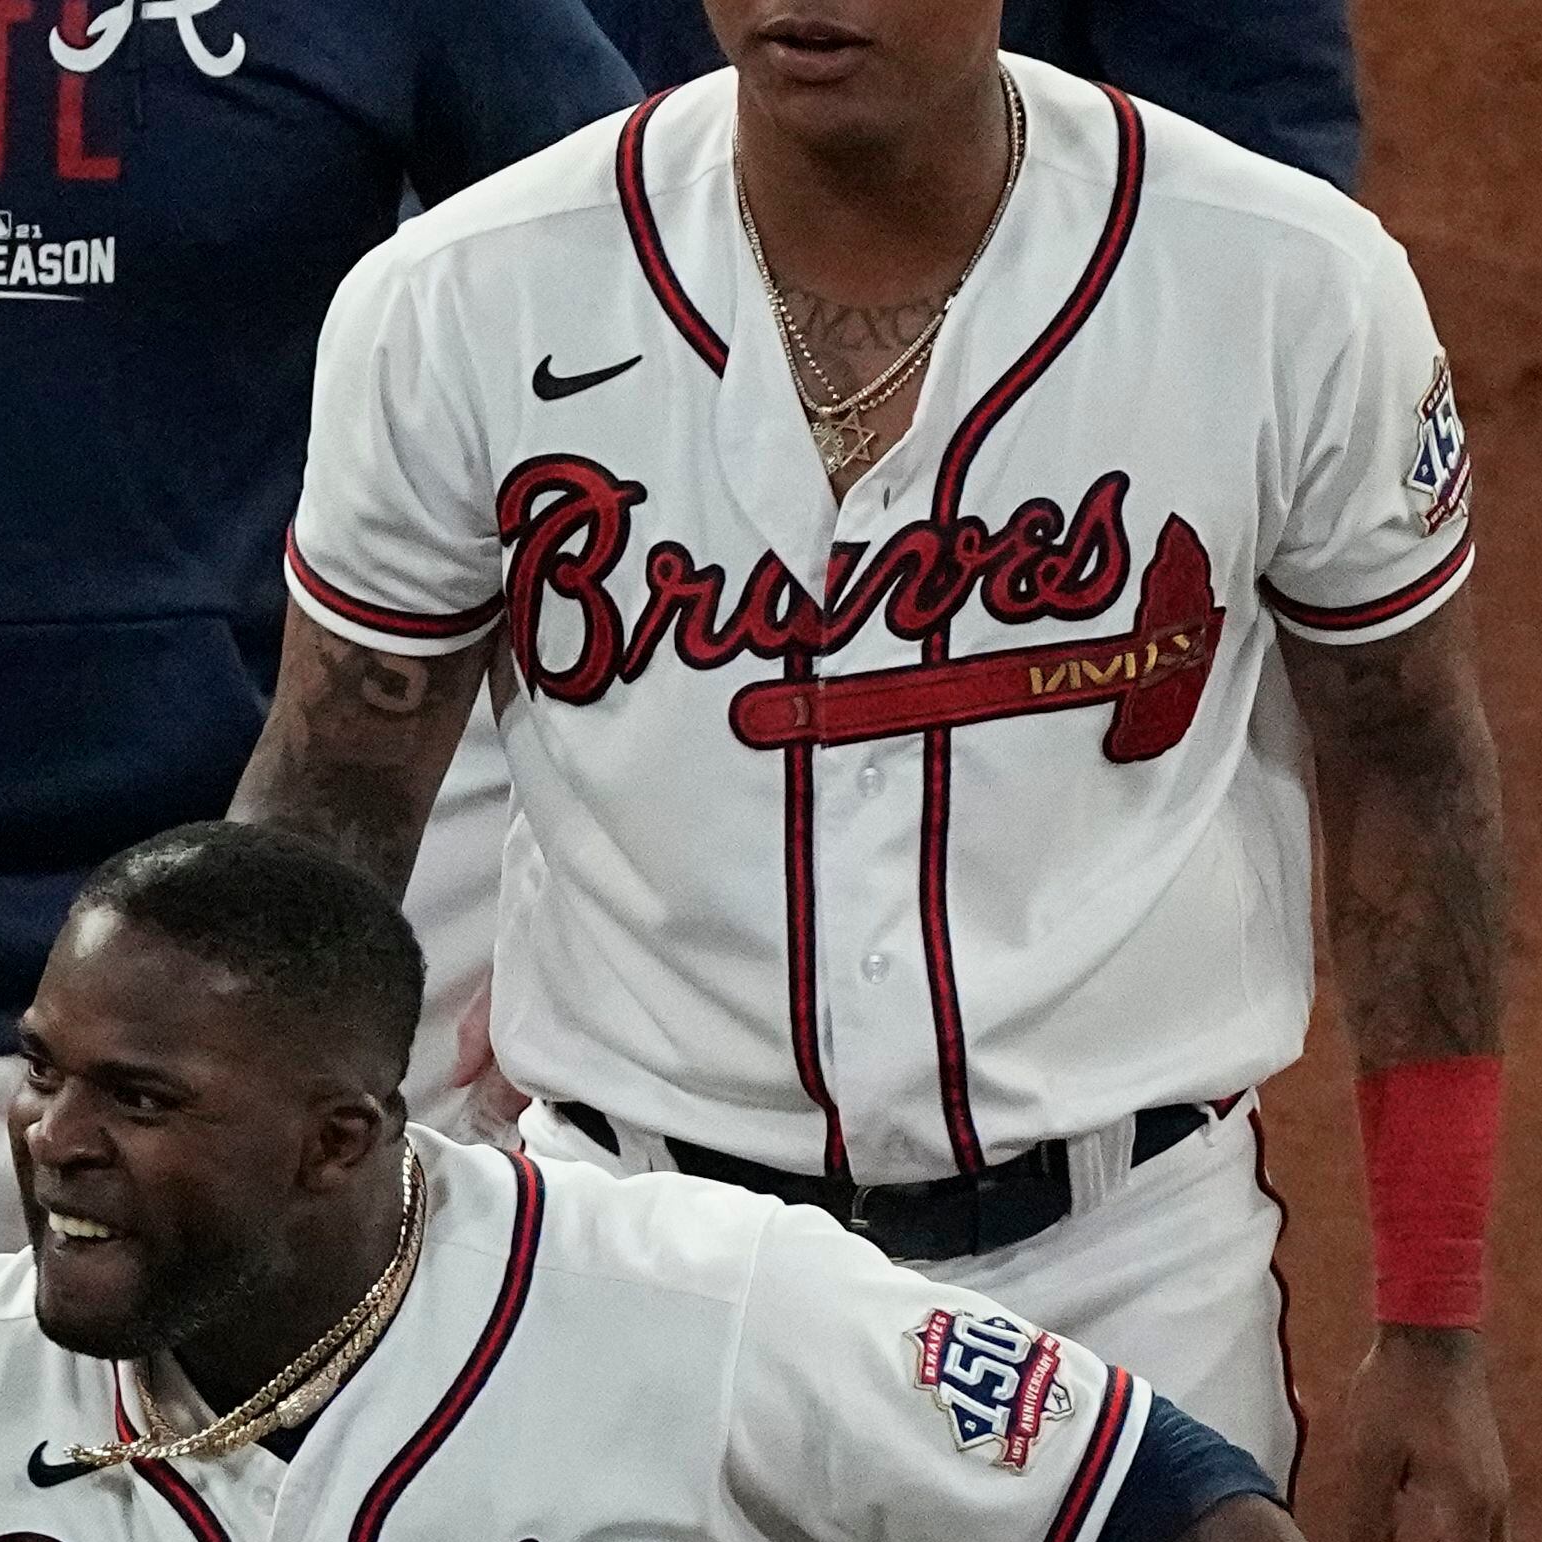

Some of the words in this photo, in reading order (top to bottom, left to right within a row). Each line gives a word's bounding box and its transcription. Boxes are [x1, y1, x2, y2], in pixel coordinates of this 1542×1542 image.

[15, 224, 43, 239] 21
[496, 453, 1130, 706] Braves
[938, 1315, 1033, 1439] 150
[1020, 1354, 1055, 1432] ANNIVERSARY
